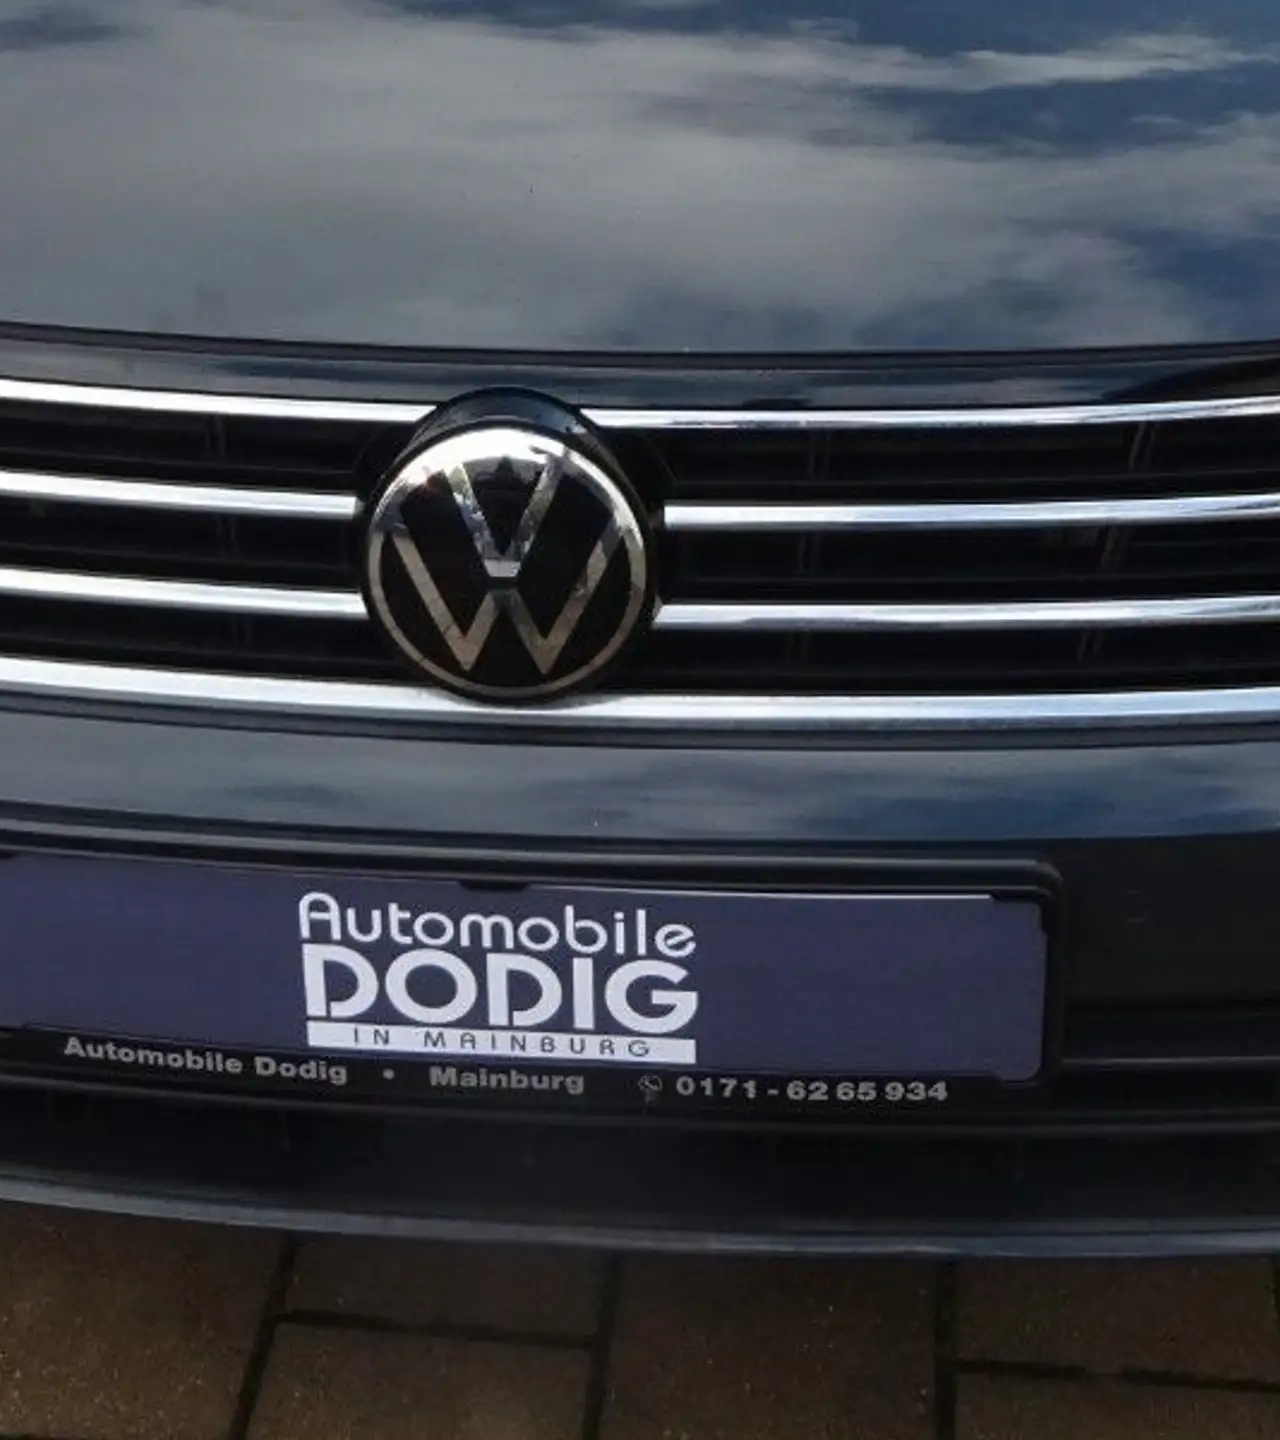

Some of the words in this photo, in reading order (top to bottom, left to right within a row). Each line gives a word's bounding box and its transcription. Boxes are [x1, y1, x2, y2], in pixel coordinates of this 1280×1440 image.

[298, 891, 698, 958] Automobile
[301, 942, 700, 1035] DODIG
[64, 1035, 244, 1075] Automobile
[254, 1055, 348, 1087] Dodig
[428, 1064, 585, 1095] Mainburg
[352, 1026, 391, 1047] IN
[422, 1027, 653, 1059] MAINBURG
